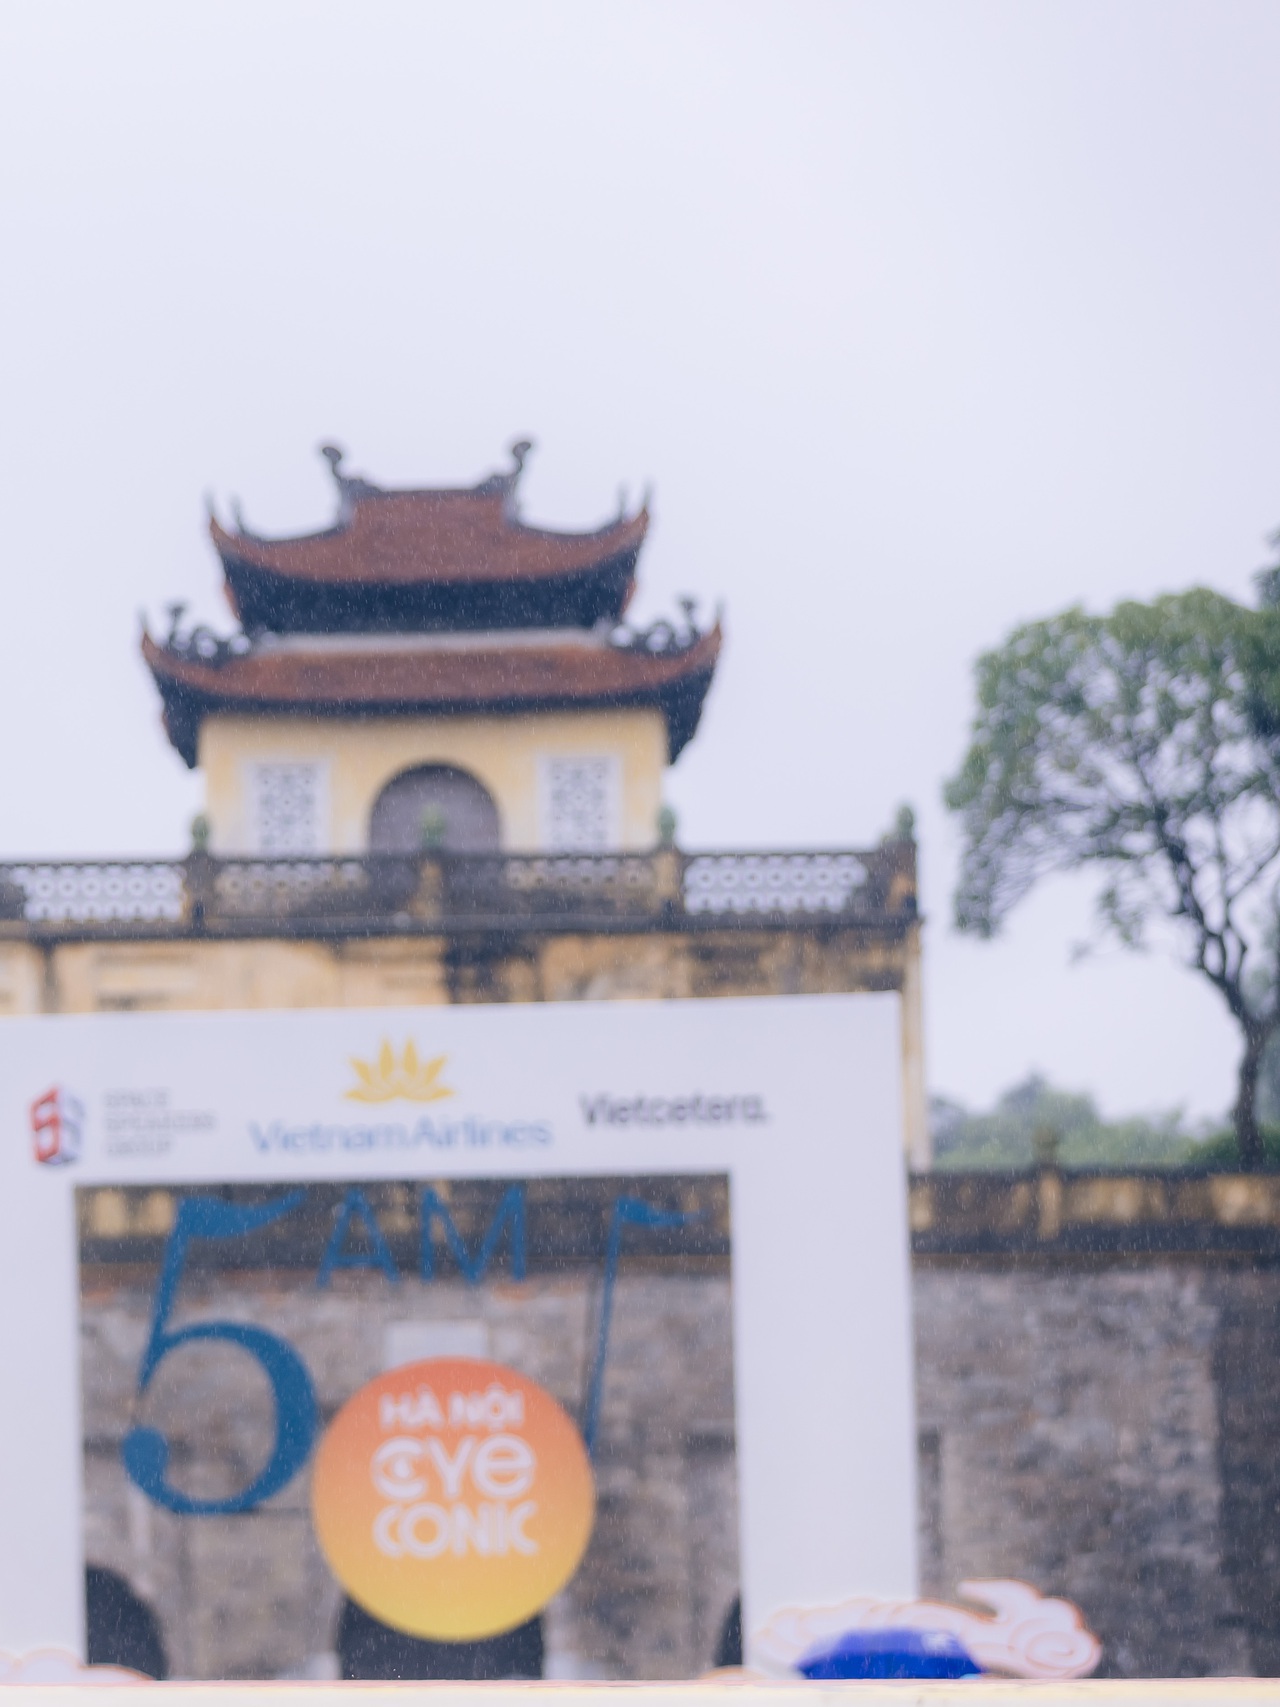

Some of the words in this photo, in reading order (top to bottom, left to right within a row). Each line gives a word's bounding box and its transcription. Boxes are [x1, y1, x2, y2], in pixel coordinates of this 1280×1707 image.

[123, 1189, 319, 1515] 5
[315, 1186, 527, 1289] AM
[374, 1501, 538, 1558] CONIC
